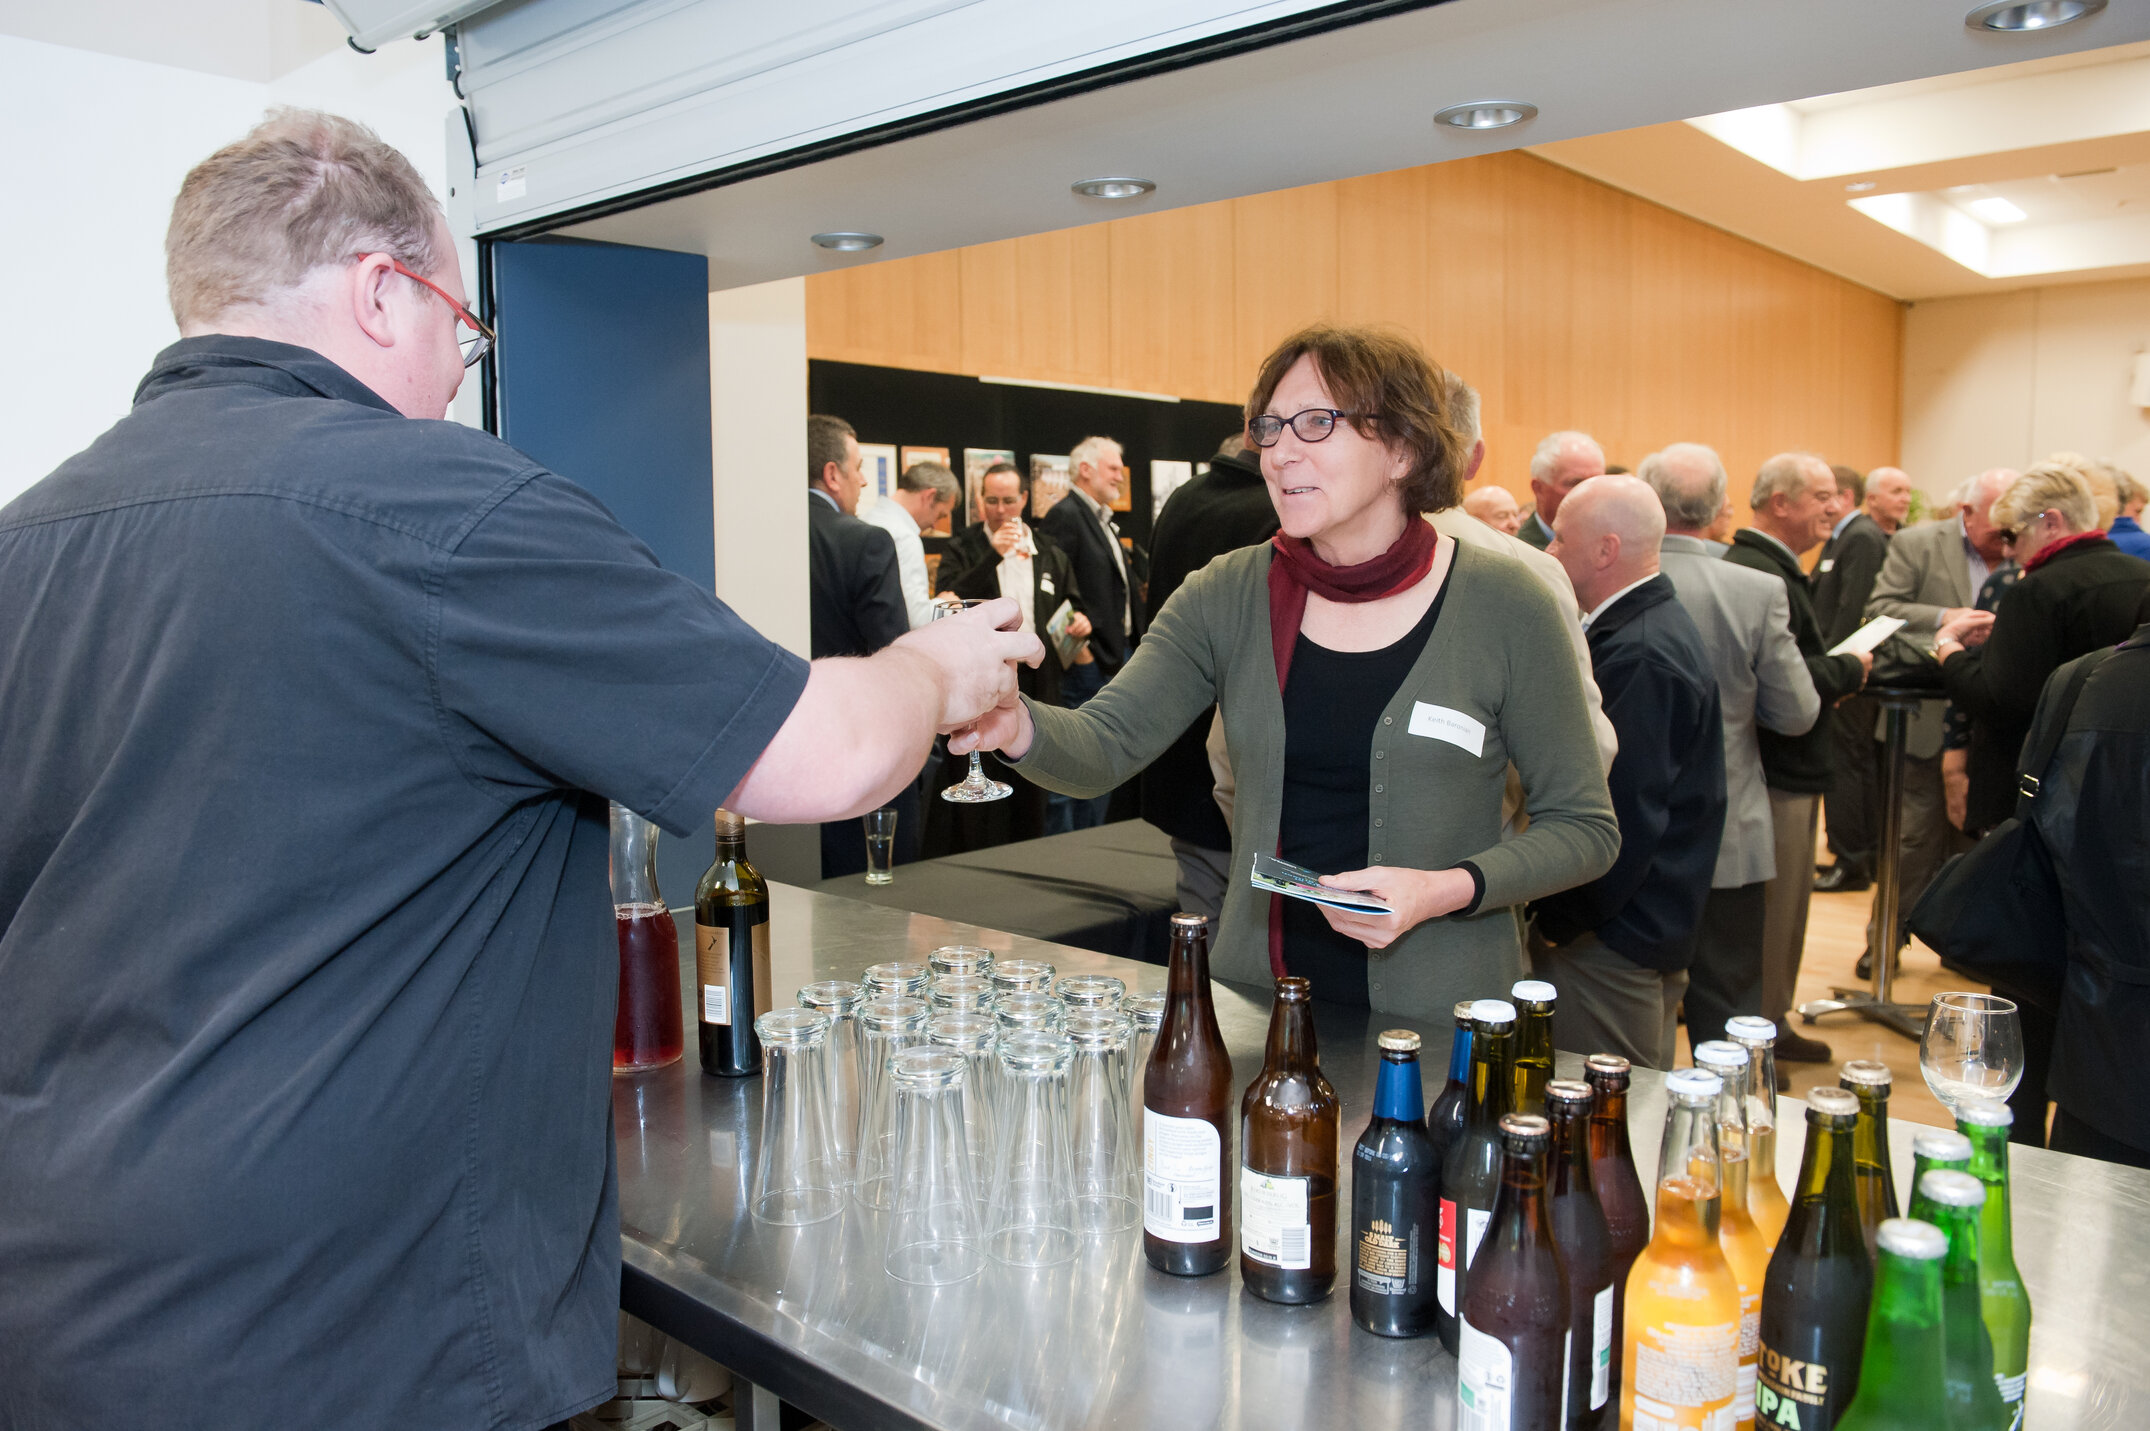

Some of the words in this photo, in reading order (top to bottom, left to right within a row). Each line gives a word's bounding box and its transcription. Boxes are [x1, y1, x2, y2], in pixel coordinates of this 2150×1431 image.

[1428, 716, 1445, 724] Keith
[1758, 1338, 1828, 1395] TOKE
[1755, 1379, 1802, 1431] IPA
